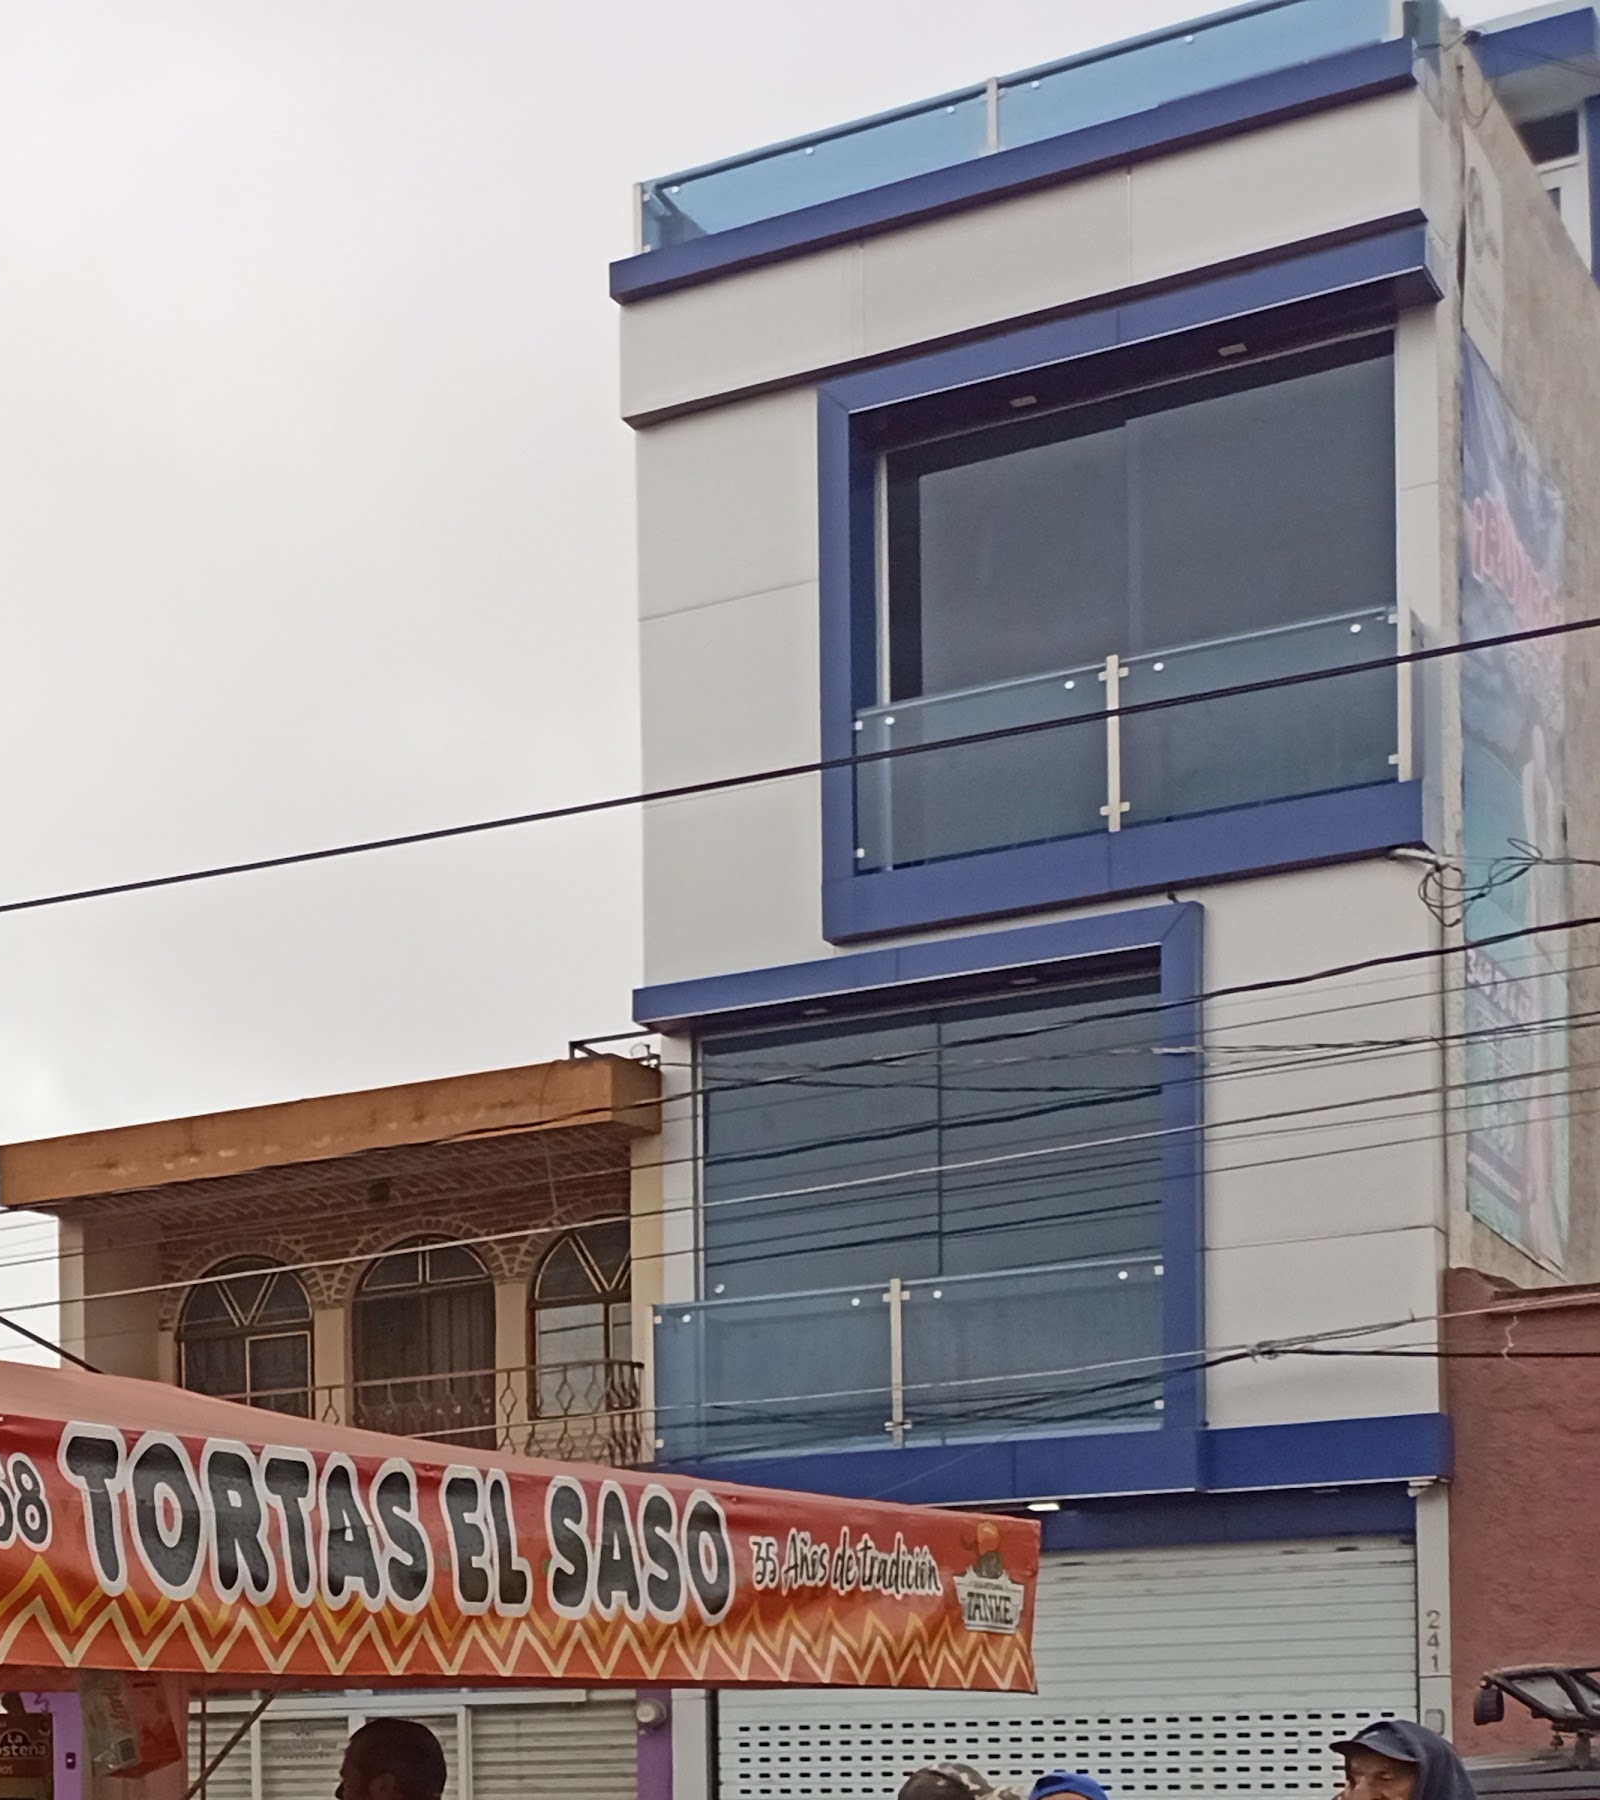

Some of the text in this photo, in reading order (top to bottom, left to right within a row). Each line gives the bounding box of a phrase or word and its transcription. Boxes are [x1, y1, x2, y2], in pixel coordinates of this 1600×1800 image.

[65, 1435, 730, 1617] TORTAS EL SASO
[752, 1530, 940, 1595] 35 Años de tradición
[1426, 1609, 1441, 1673] 241
[7, 1733, 23, 1744] La
